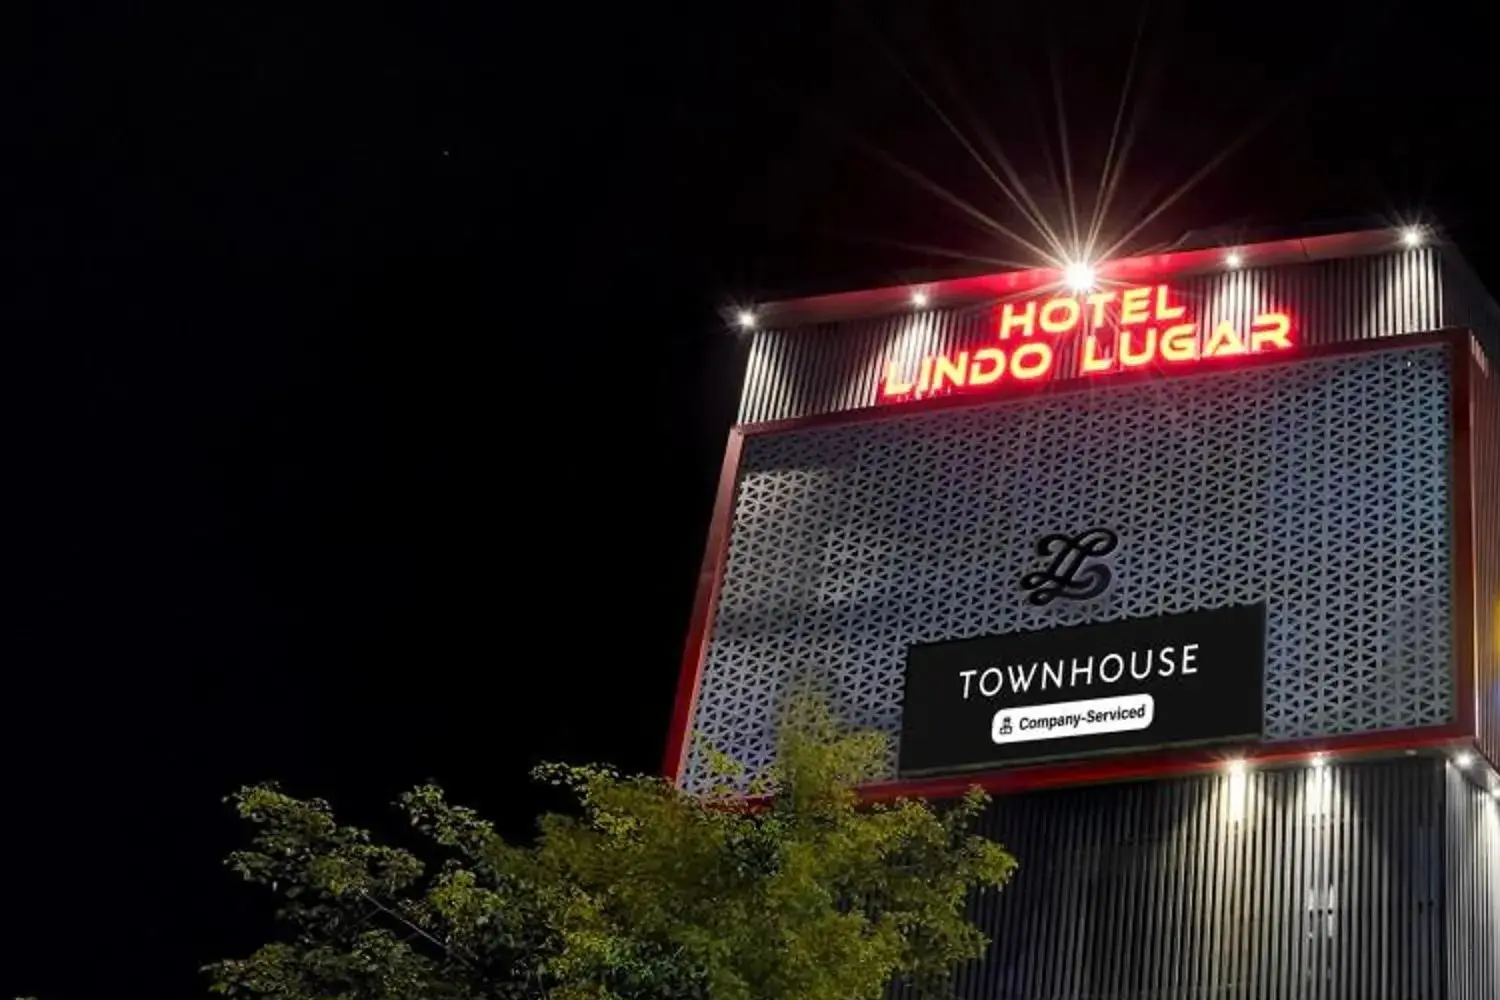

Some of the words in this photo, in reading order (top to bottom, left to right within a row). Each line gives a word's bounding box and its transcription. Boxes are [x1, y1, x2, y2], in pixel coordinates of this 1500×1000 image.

[1000, 284, 1186, 340] HOTEL
[884, 342, 1053, 400] LINDO
[1082, 312, 1292, 372] LUGAR
[959, 643, 1200, 700] TOWNHOUSE
[1019, 703, 1146, 732] Company-Serviced
